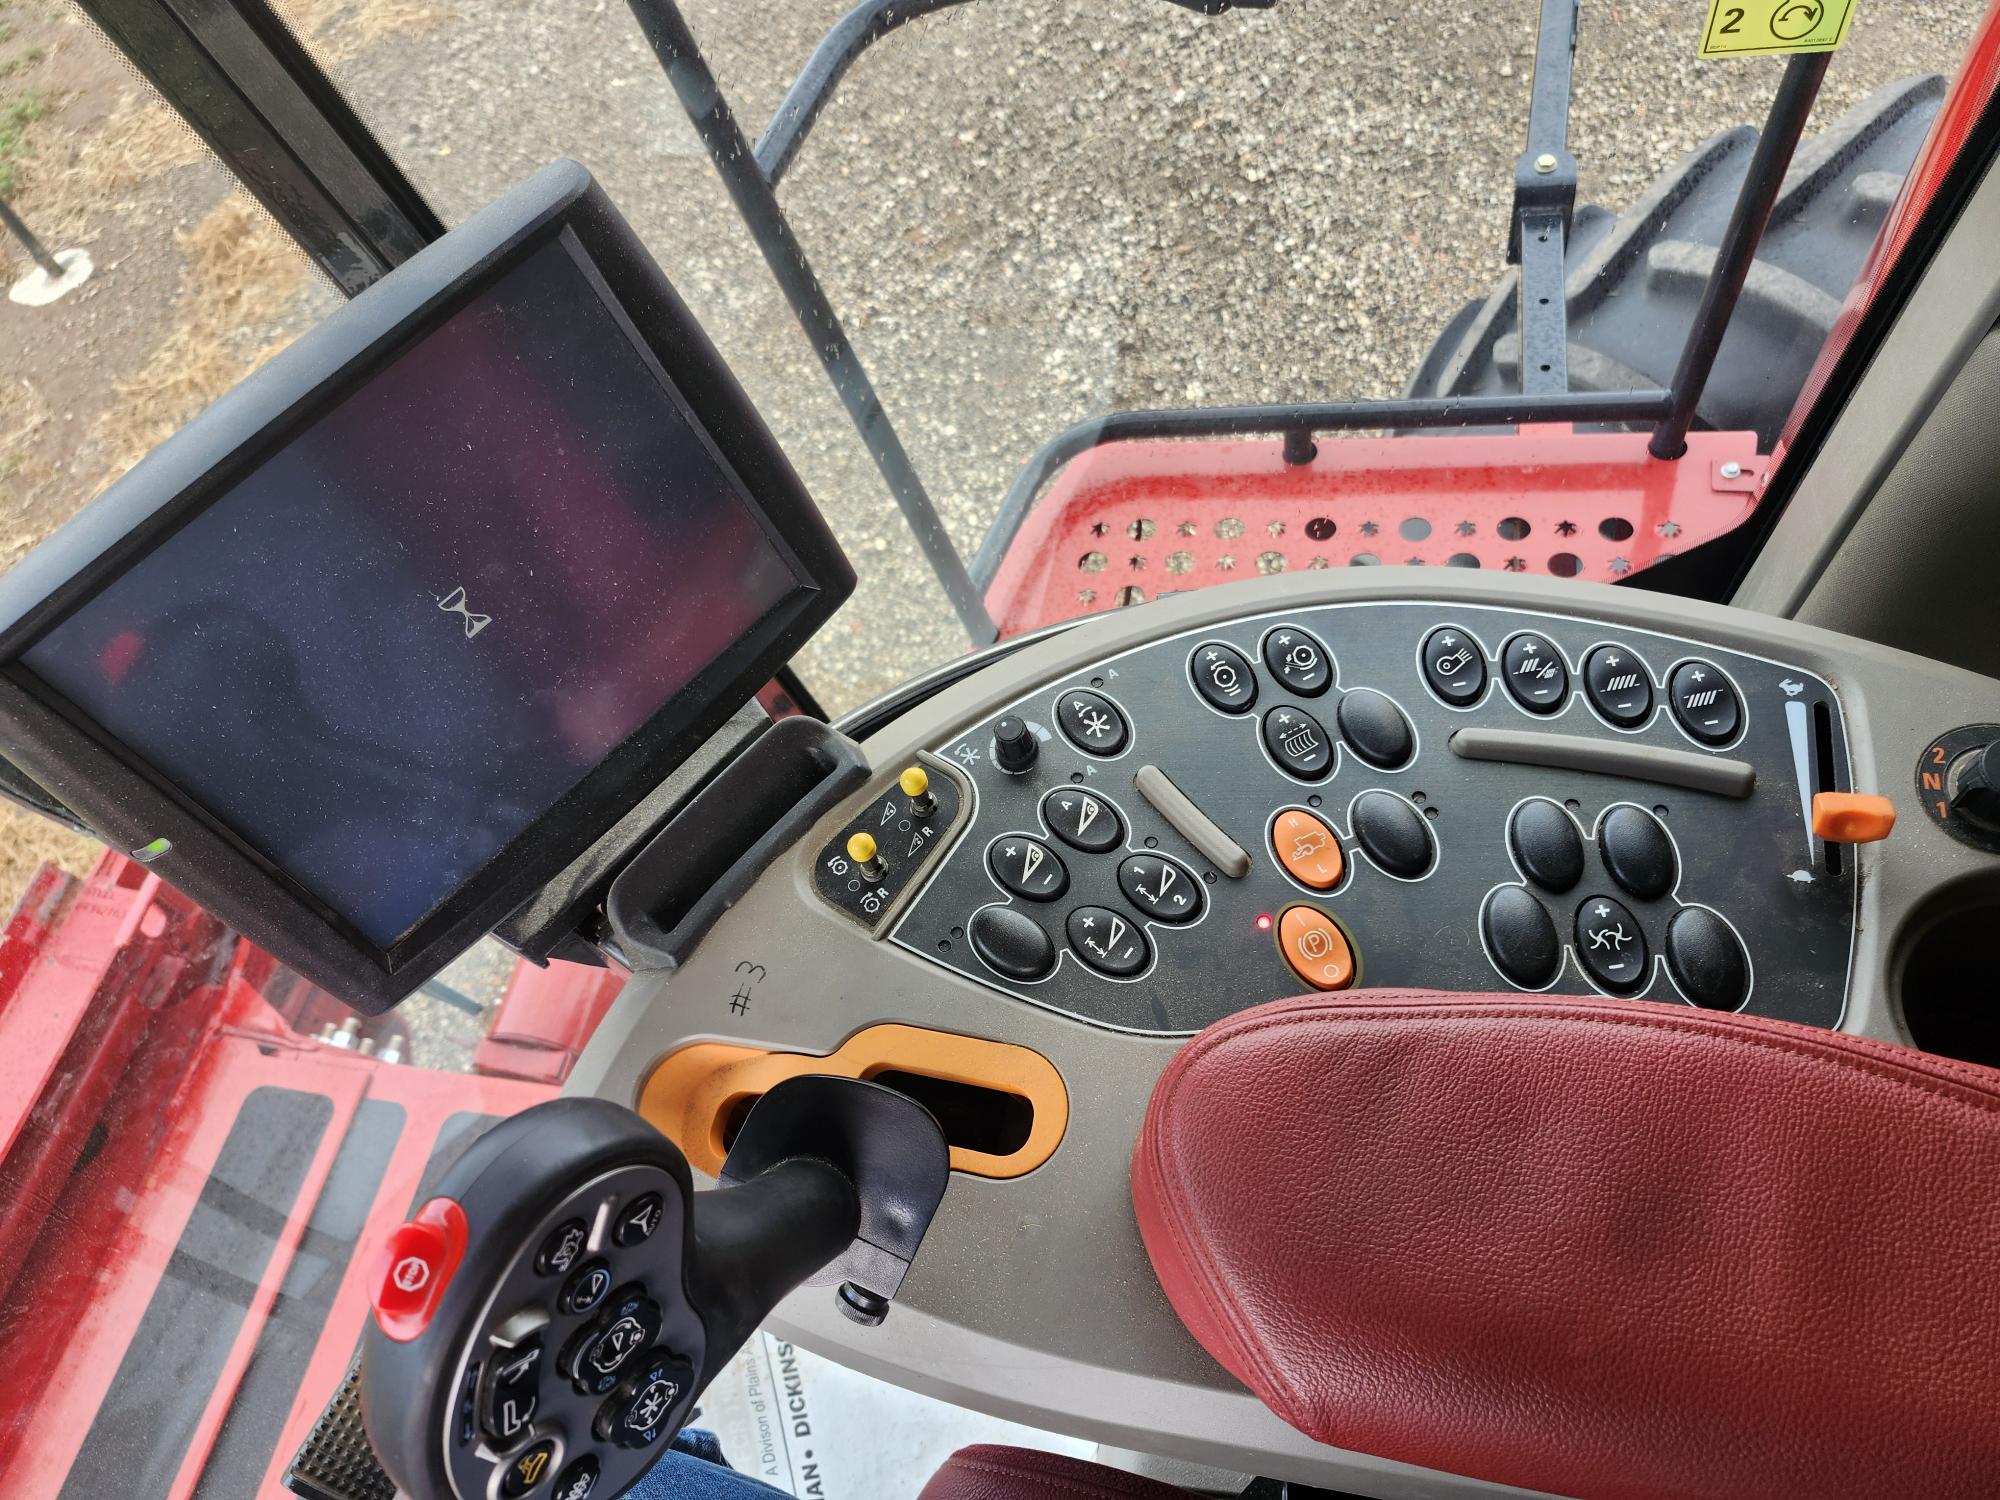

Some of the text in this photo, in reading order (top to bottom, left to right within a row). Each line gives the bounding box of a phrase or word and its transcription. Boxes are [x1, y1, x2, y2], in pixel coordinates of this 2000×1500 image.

[1719, 8, 1745, 35] 2
[1108, 668, 1119, 680] A
[1073, 700, 1084, 711] A
[1932, 747, 1946, 764] 2
[1086, 765, 1097, 776] A
[1922, 772, 1942, 790] N
[1061, 799, 1072, 811] A
[1935, 801, 1947, 818] 1
[1287, 817, 1298, 828] H
[921, 826, 934, 838] R
[1317, 864, 1328, 874] L
[876, 887, 889, 899] R
[1308, 933, 1320, 953] P
[729, 960, 767, 1017] #3
[746, 1358, 762, 1397] Plains
[751, 1399, 767, 1413] of
[766, 1467, 779, 1476] A
[801, 1463, 825, 1500] AN
